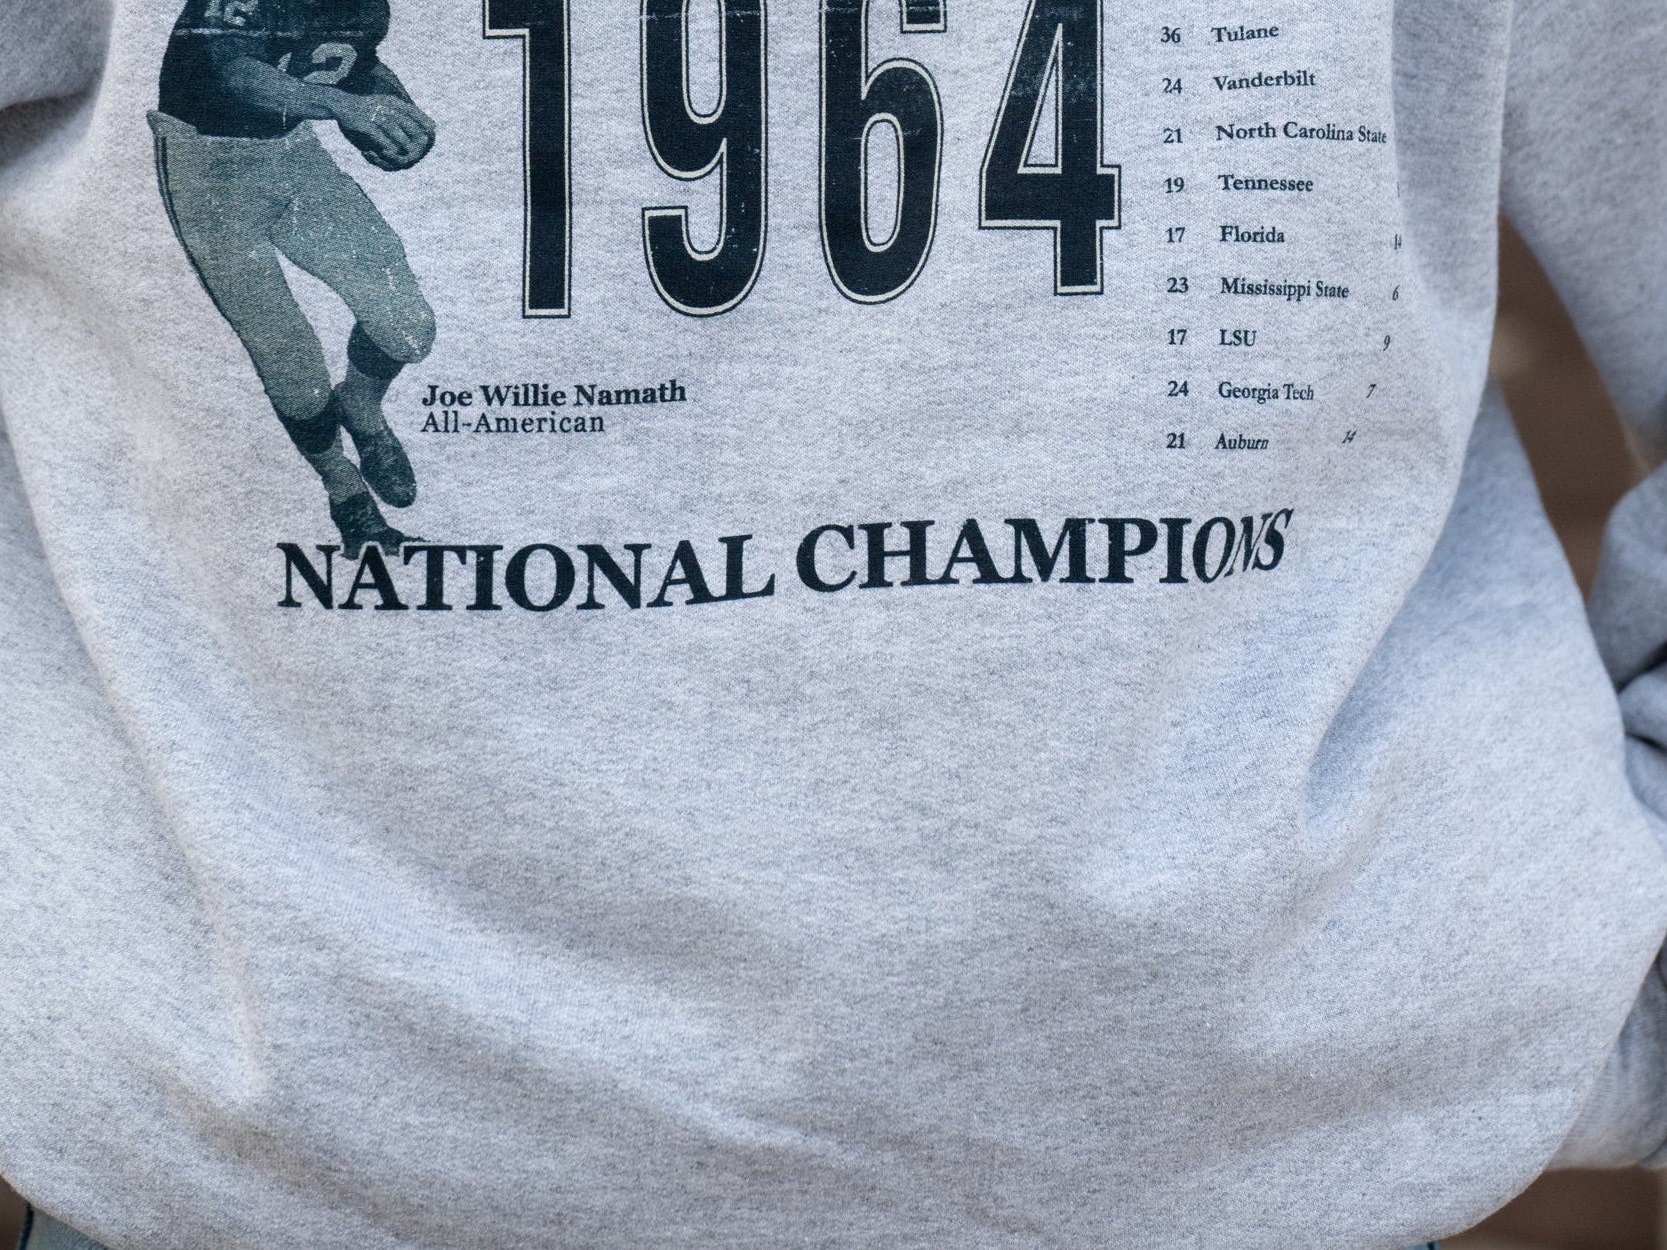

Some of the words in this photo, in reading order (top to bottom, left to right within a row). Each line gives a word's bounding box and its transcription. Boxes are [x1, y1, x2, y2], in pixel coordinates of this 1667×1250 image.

[1160, 27, 1181, 44] 36
[1211, 24, 1279, 43] Tulane
[1162, 78, 1183, 94] 24
[1214, 70, 1316, 91] Vanderbilt
[1163, 128, 1183, 144] 21
[1215, 122, 1277, 141] North
[1283, 122, 1353, 141] Carolina
[1358, 126, 1387, 144] State
[1164, 178, 1185, 194] 19
[1218, 174, 1314, 192] Tennessee
[1166, 227, 1186, 243] 17
[1220, 225, 1285, 244] Florida
[1167, 277, 1189, 294] 23
[1220, 277, 1311, 302] Mississippi
[1316, 280, 1349, 298] State
[1392, 285, 1400, 301] 6
[1167, 329, 1188, 345] 17
[1220, 330, 1257, 347] LSU
[1383, 335, 1391, 351] 9
[422, 384, 473, 407] Joe
[479, 383, 567, 407] Willie
[573, 379, 687, 406] Namath
[1167, 381, 1189, 397] 24
[1219, 382, 1279, 403] Georgia
[1282, 384, 1314, 401] Tech
[1366, 384, 1377, 398] 7
[421, 411, 605, 433] All-American
[1166, 432, 1186, 449] 21
[1214, 434, 1270, 450] Auburn
[276, 533, 776, 612] NATIONAL
[795, 508, 1295, 593] CHAMPIONS
